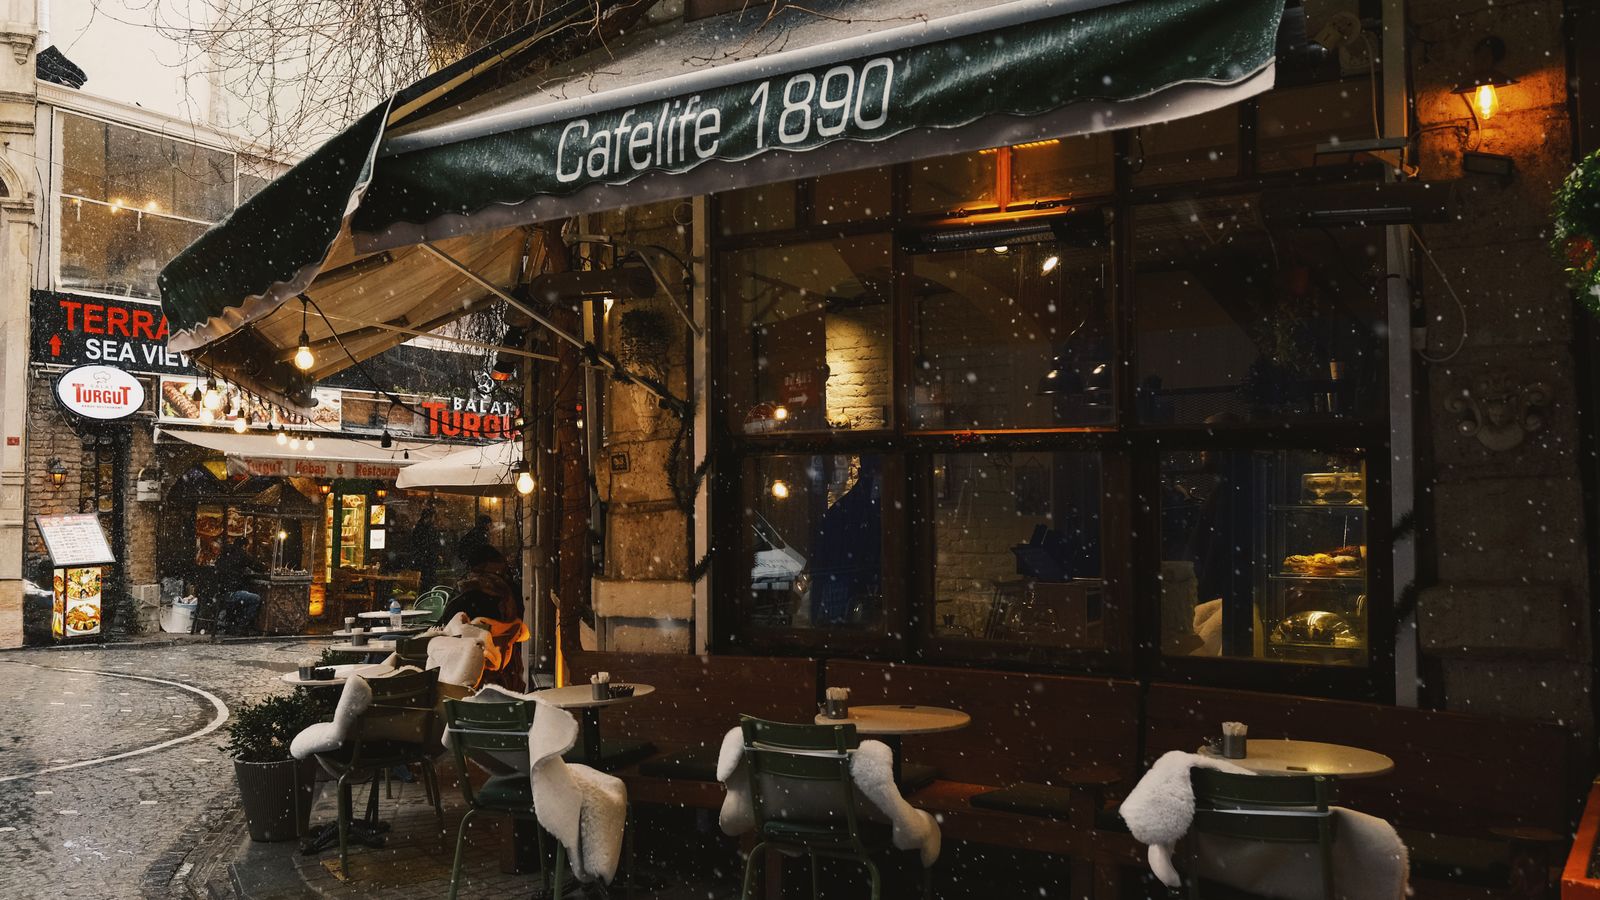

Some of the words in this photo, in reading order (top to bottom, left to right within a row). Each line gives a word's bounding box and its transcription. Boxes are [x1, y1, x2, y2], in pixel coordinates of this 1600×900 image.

[556, 95, 721, 184] Cafelife
[750, 57, 895, 149] 1890
[85, 338, 136, 363] SEA
[453, 397, 512, 414] BALAT
[295, 461, 326, 477] Kebap
[336, 463, 344, 475] &
